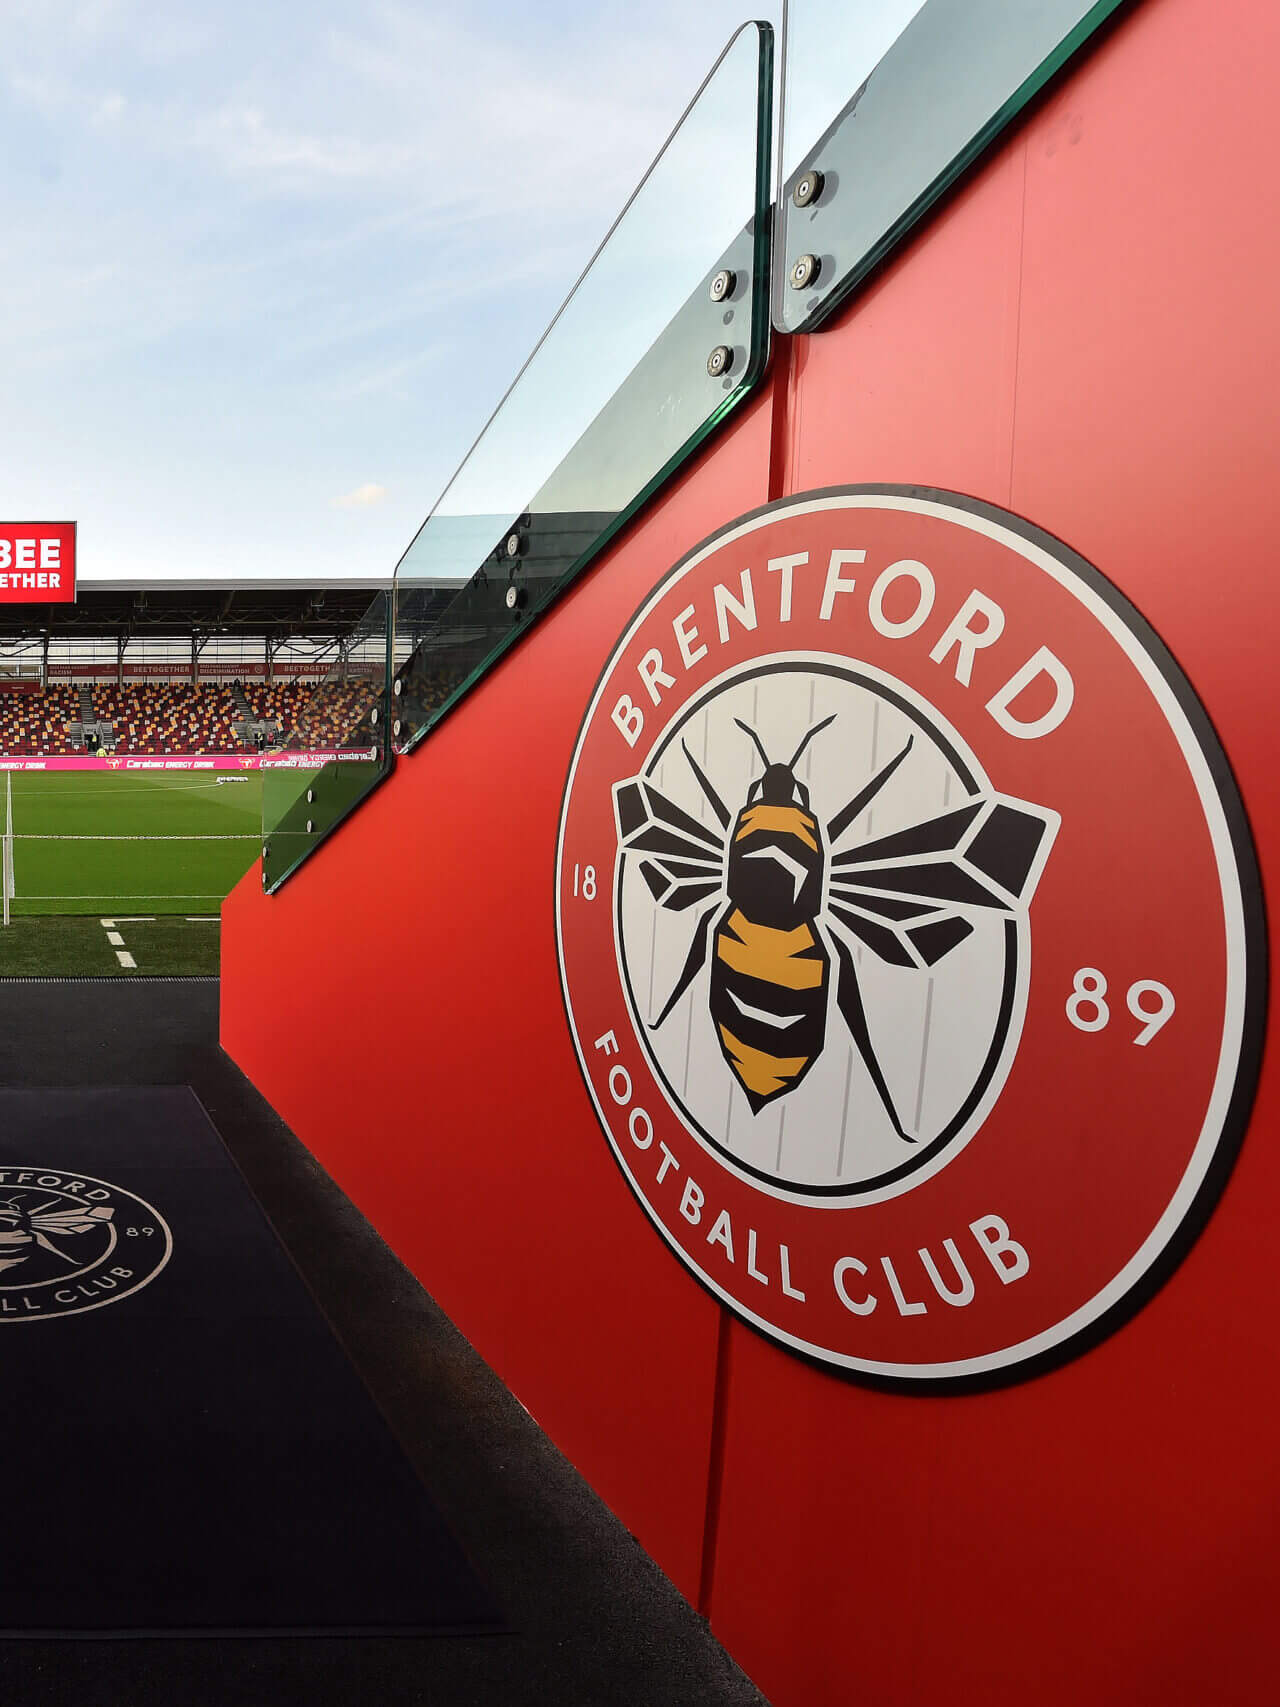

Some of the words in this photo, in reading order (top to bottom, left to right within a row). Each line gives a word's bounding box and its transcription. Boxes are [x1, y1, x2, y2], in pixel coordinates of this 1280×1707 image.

[612, 549, 1075, 748] BRENTFORD
[126, 760, 164, 768] Carabao
[573, 864, 597, 901] 18
[1065, 967, 1176, 1046] 89
[594, 1029, 806, 1302] FOOTBALL
[833, 1214, 1031, 1316] CLUB
[125, 1227, 155, 1238] 89
[55, 1266, 134, 1304] CLUB
